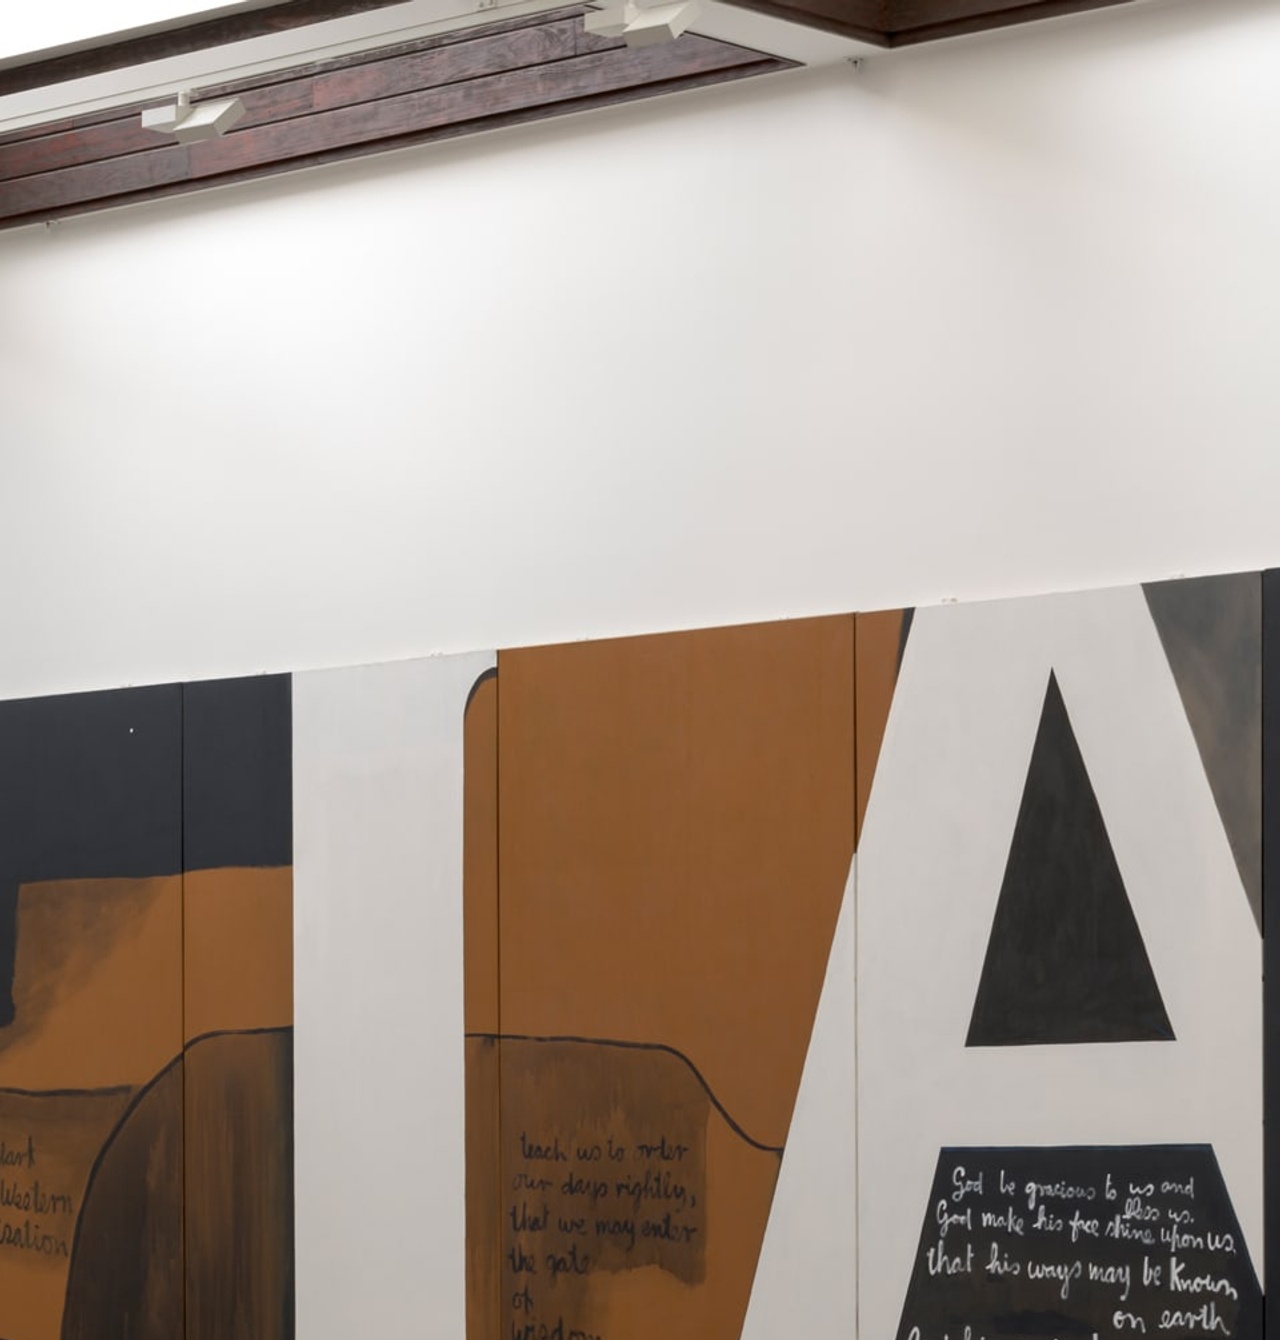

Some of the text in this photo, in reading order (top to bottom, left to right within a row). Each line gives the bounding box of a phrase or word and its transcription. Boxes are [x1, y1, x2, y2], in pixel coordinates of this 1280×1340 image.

[520, 1132, 690, 1161] teach us to order
[511, 1172, 697, 1212] our days rightly,
[952, 1166, 1195, 1211] God be gracious to us and
[1122, 1196, 1160, 1221] bless
[510, 1202, 699, 1251] that we may enter
[936, 1200, 972, 1238] God
[982, 1206, 1024, 1236] make
[1033, 1205, 1063, 1232] his
[1105, 1213, 1155, 1245] shine
[1160, 1223, 1204, 1252] upon
[508, 1243, 589, 1283] the gate
[926, 1240, 974, 1276] that
[986, 1241, 1021, 1277] his
[1027, 1260, 1080, 1300] ways
[1089, 1260, 1131, 1302] may
[1143, 1256, 1162, 1287] be
[511, 1286, 534, 1315] of
[1112, 1303, 1232, 1336] on earth
